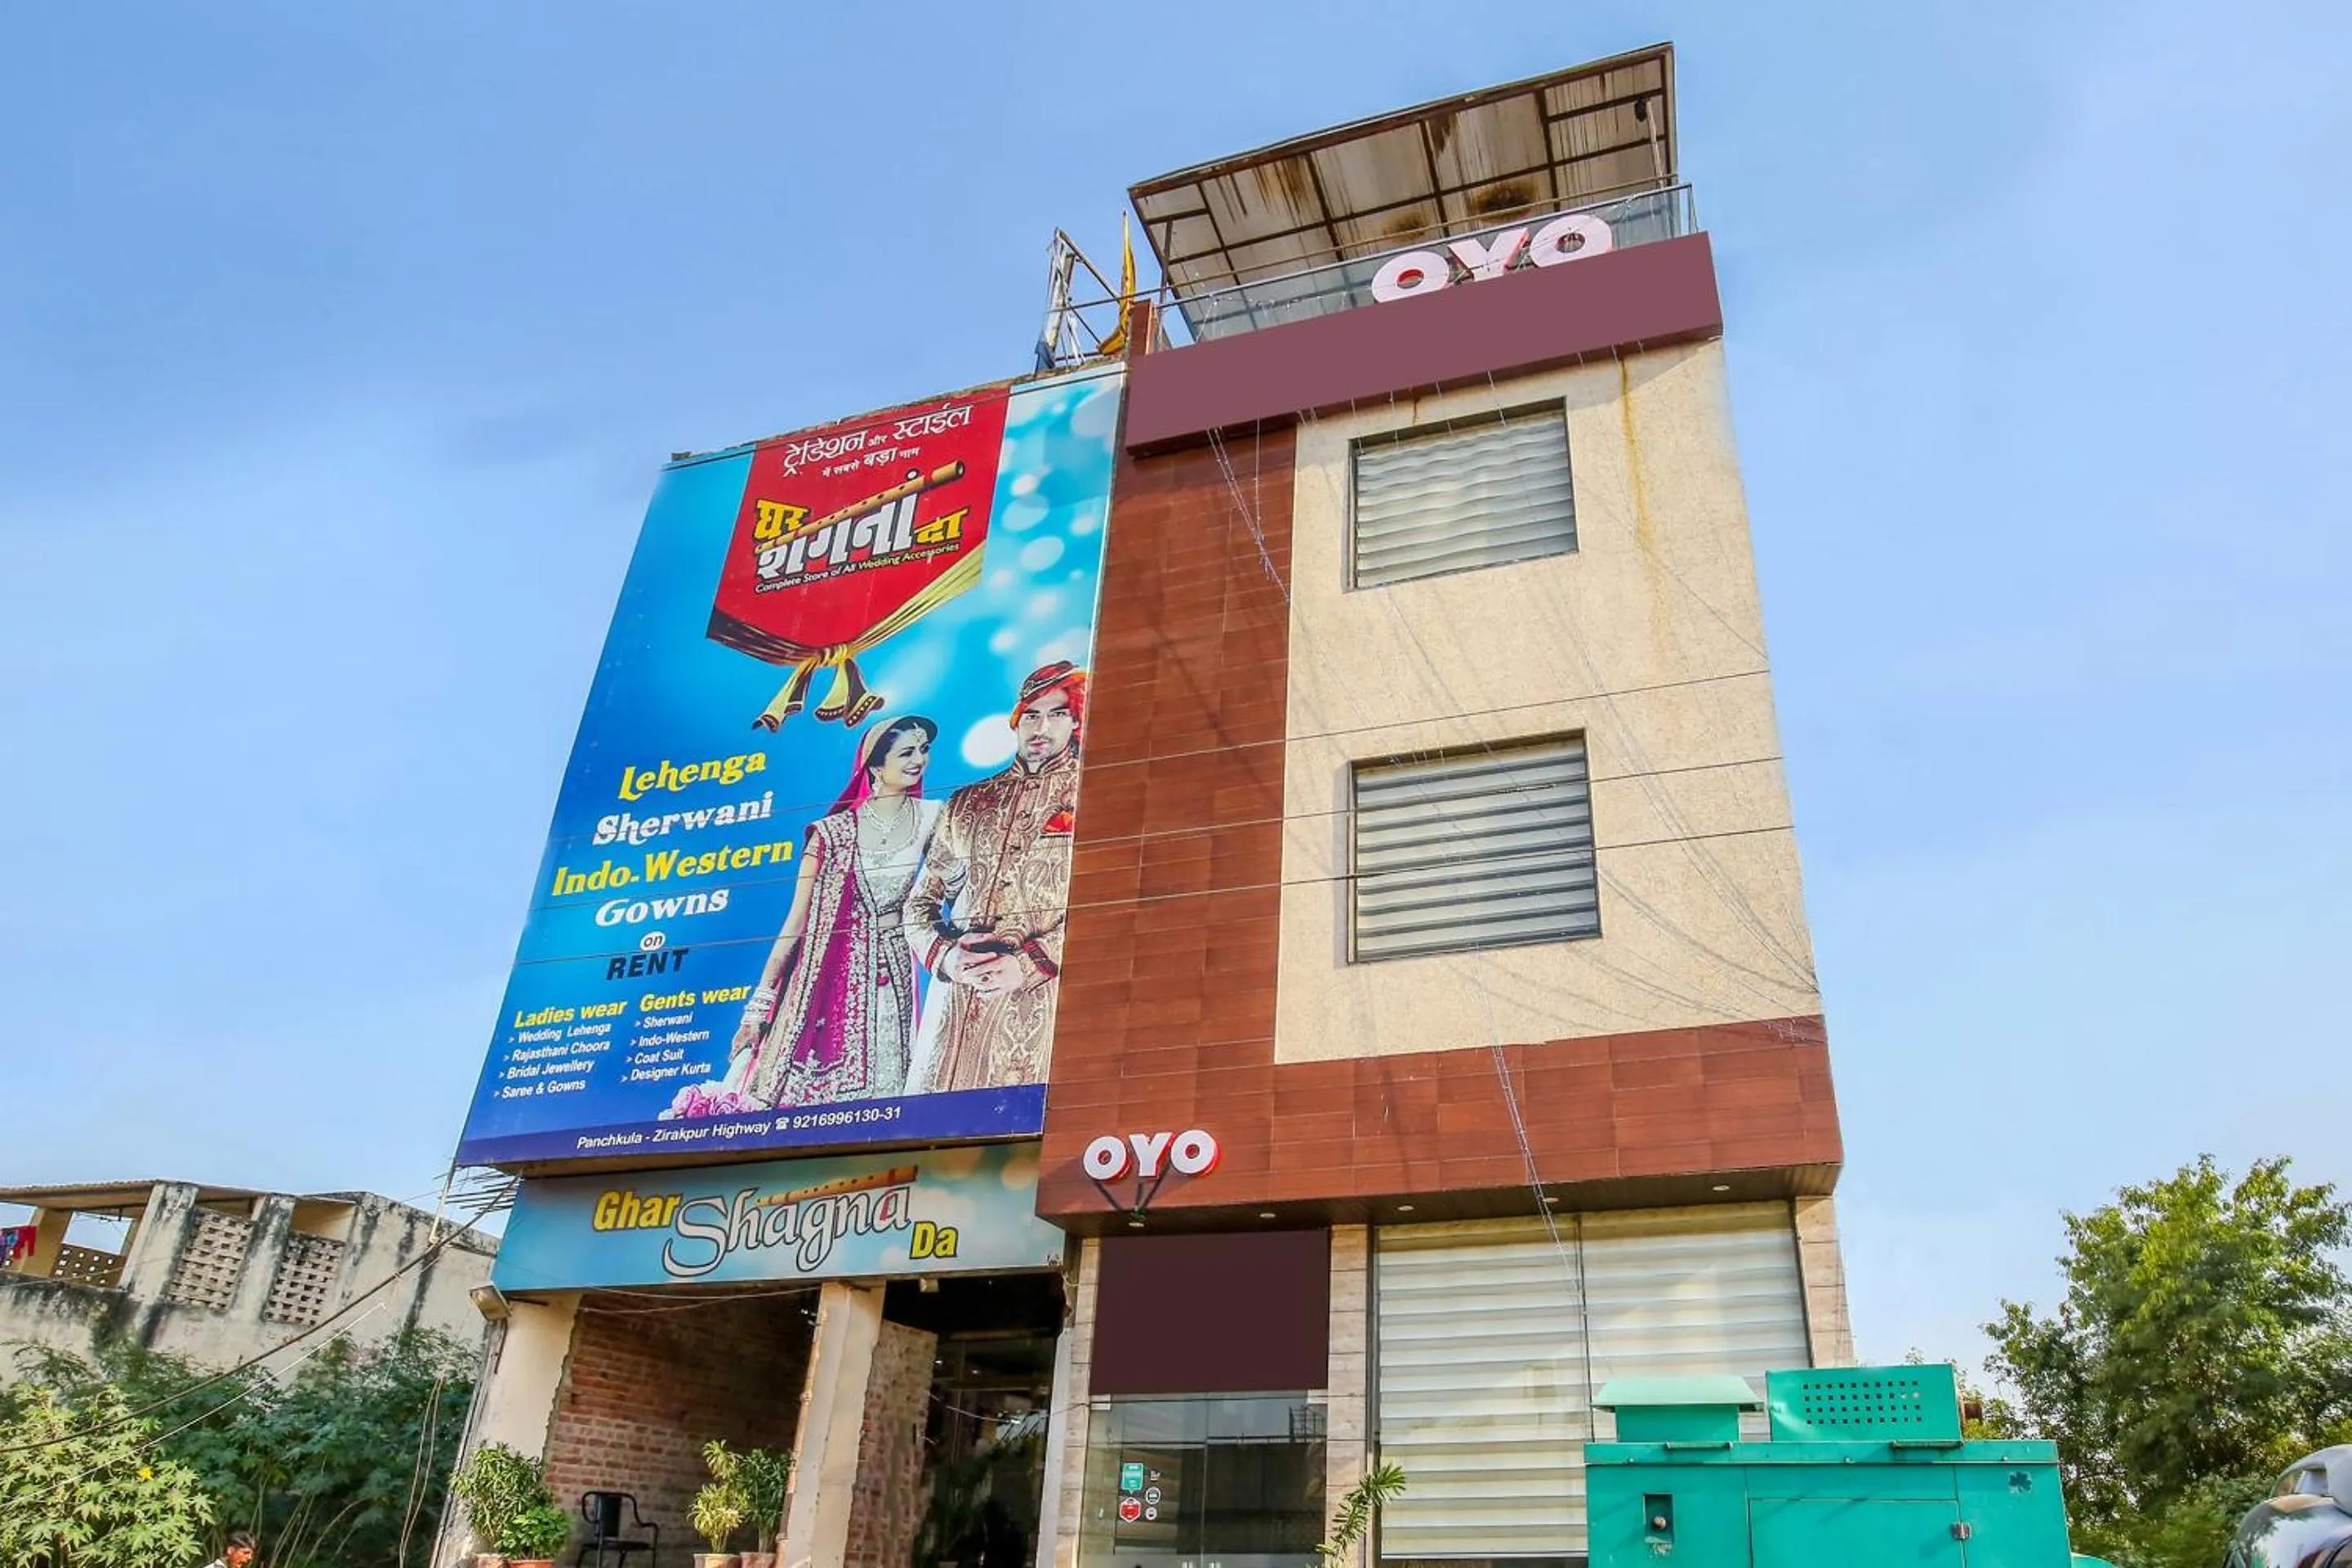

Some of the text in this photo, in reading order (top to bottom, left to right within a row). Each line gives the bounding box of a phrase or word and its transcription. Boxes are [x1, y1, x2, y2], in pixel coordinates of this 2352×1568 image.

[1371, 214, 1613, 303] OYO
[868, 435, 887, 447] और
[893, 403, 973, 440] स्टाईल
[863, 447, 898, 466] बड़ा
[754, 500, 809, 539] घर
[755, 544, 959, 593] Complete Store of All Wedding Accessories
[618, 751, 767, 801] Lehenga
[592, 791, 774, 845] Sherwani
[595, 889, 729, 927] Gowns
[643, 934, 662, 947] on
[607, 948, 689, 980] RENT
[639, 985, 751, 1012] Gents wear
[514, 1000, 627, 1028] Ladies wear
[643, 1011, 693, 1028] Sherwani
[519, 1022, 612, 1043] Wedding Lehenga
[639, 1031, 710, 1047] Indo-Western
[511, 1040, 611, 1062] Rajasthani Choora
[634, 1049, 684, 1064] Coat Suit
[506, 1059, 595, 1079] Bridal Jewellery
[630, 1062, 711, 1081] Designer Kurta
[501, 1080, 586, 1098] Saree & Gowns
[577, 1133, 642, 1149] Panchkula
[653, 1127, 709, 1143] Zirakpur
[711, 1122, 771, 1138] Highway
[793, 1107, 902, 1129] 9216996130-31
[1083, 1129, 1220, 1183] OYO
[593, 1187, 959, 1276] Ghar Shagna Da
